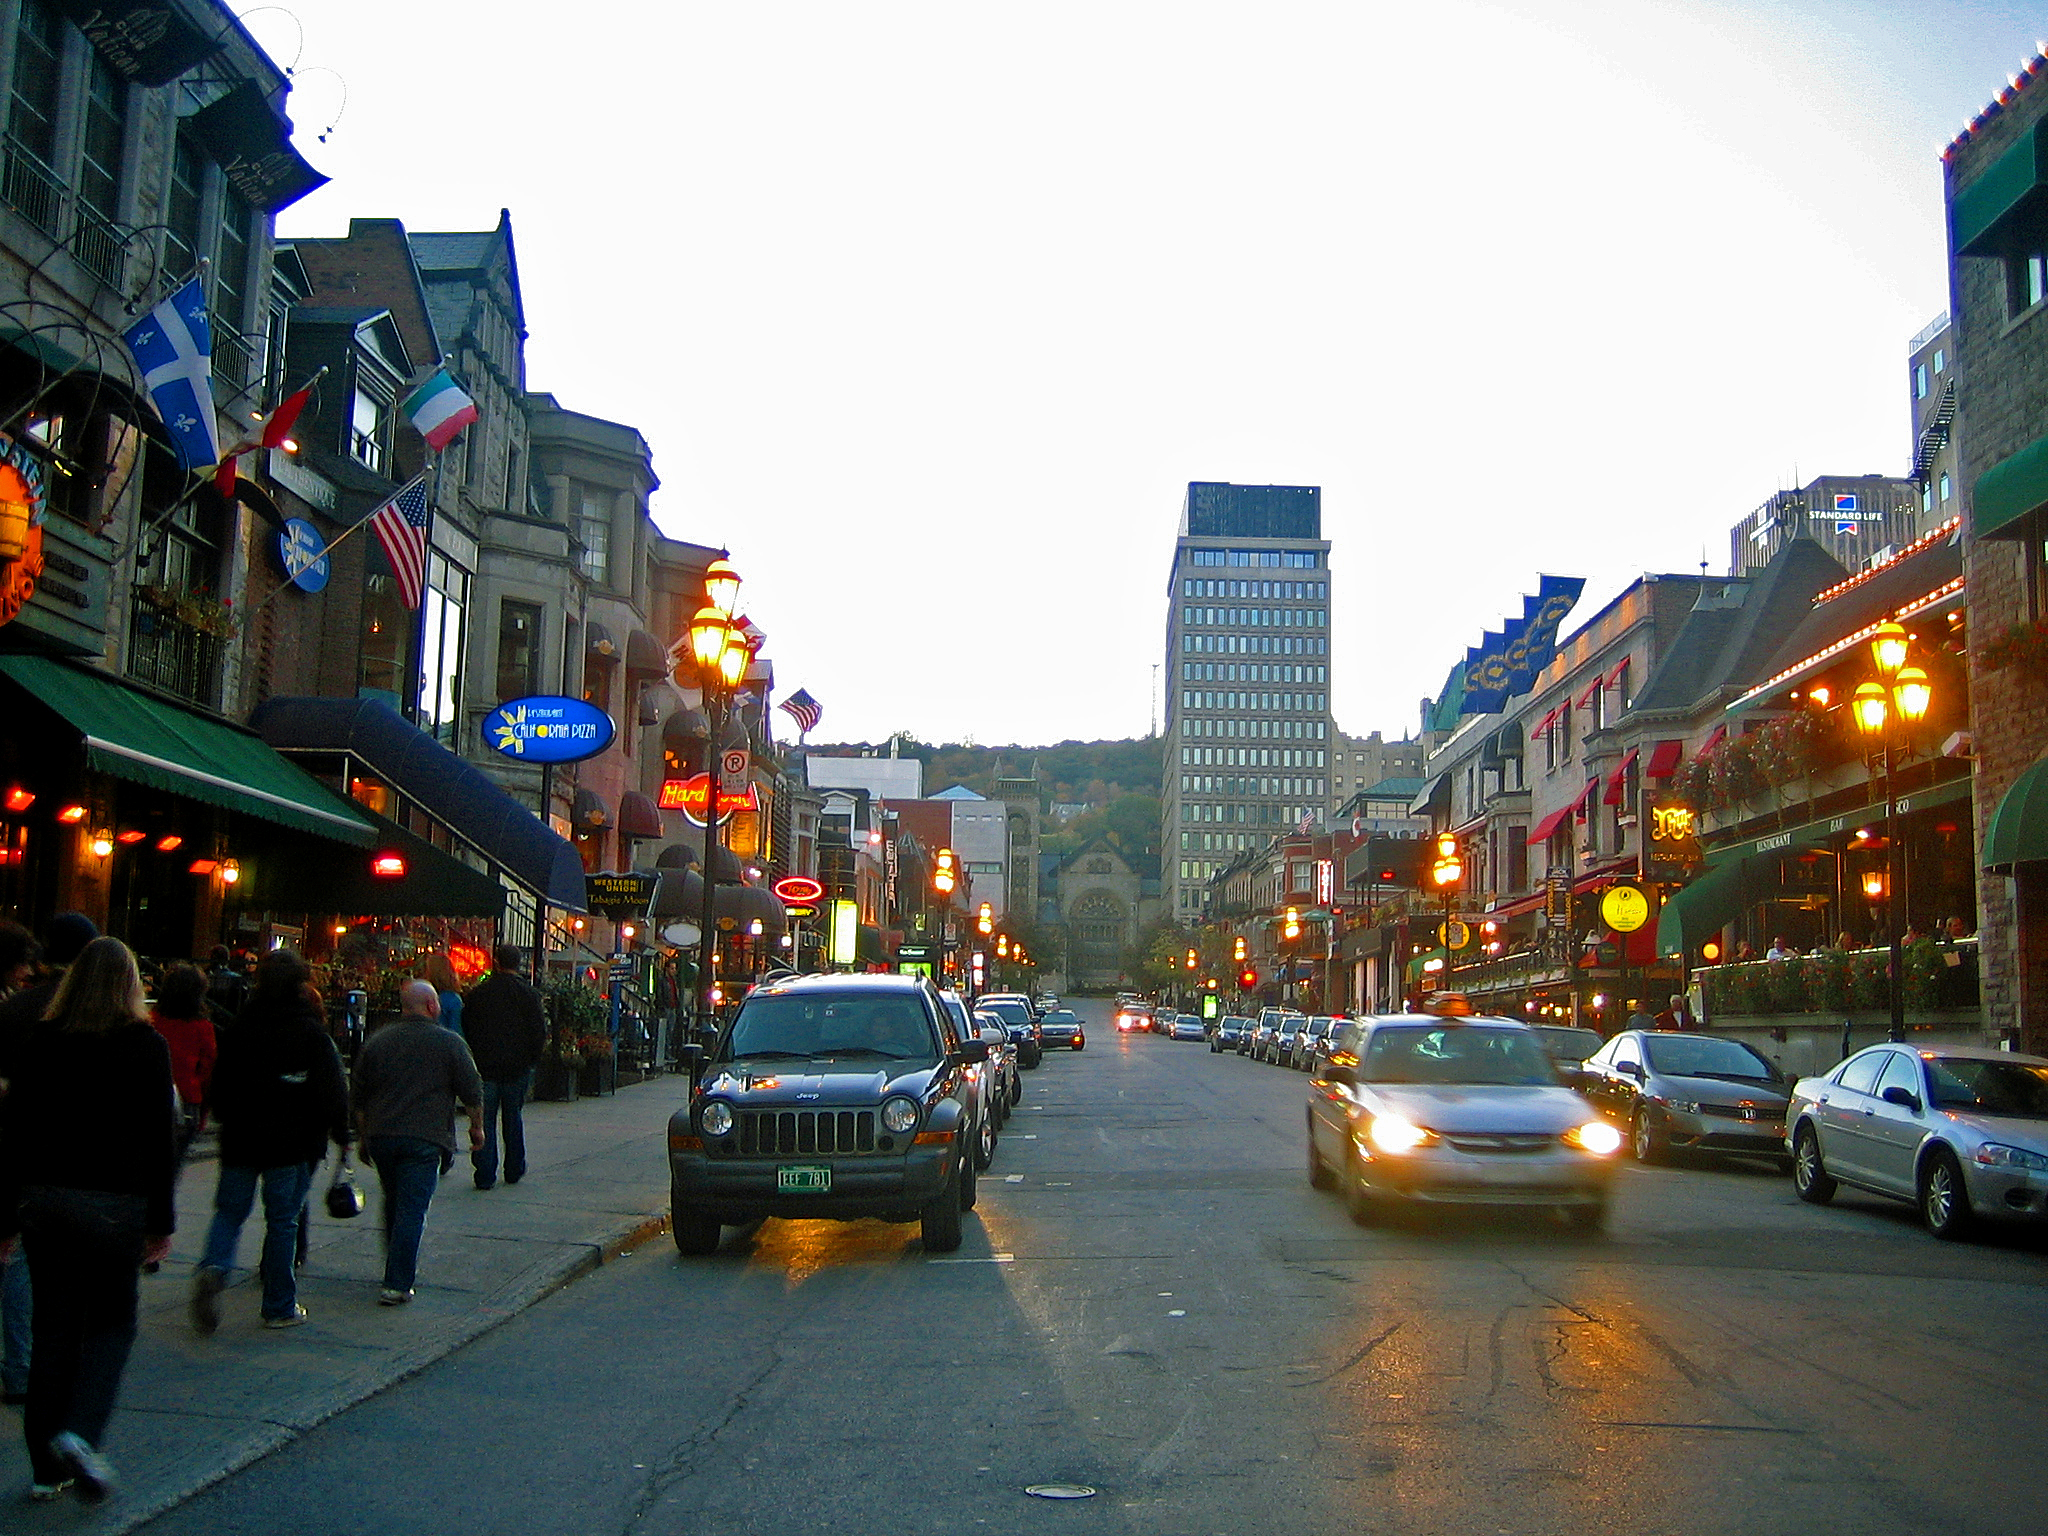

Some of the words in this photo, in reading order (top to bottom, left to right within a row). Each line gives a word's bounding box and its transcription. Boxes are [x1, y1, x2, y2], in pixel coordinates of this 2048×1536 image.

[81, 9, 141, 75] Vatican
[1809, 510, 1862, 521] STANDARD
[1863, 511, 1883, 521] LIFE
[571, 723, 596, 739] PIZZA
[664, 784, 708, 805] Hard
[593, 878, 637, 886] WESTERN
[606, 885, 637, 893] UNION
[796, 1092, 820, 1100] Jeep
